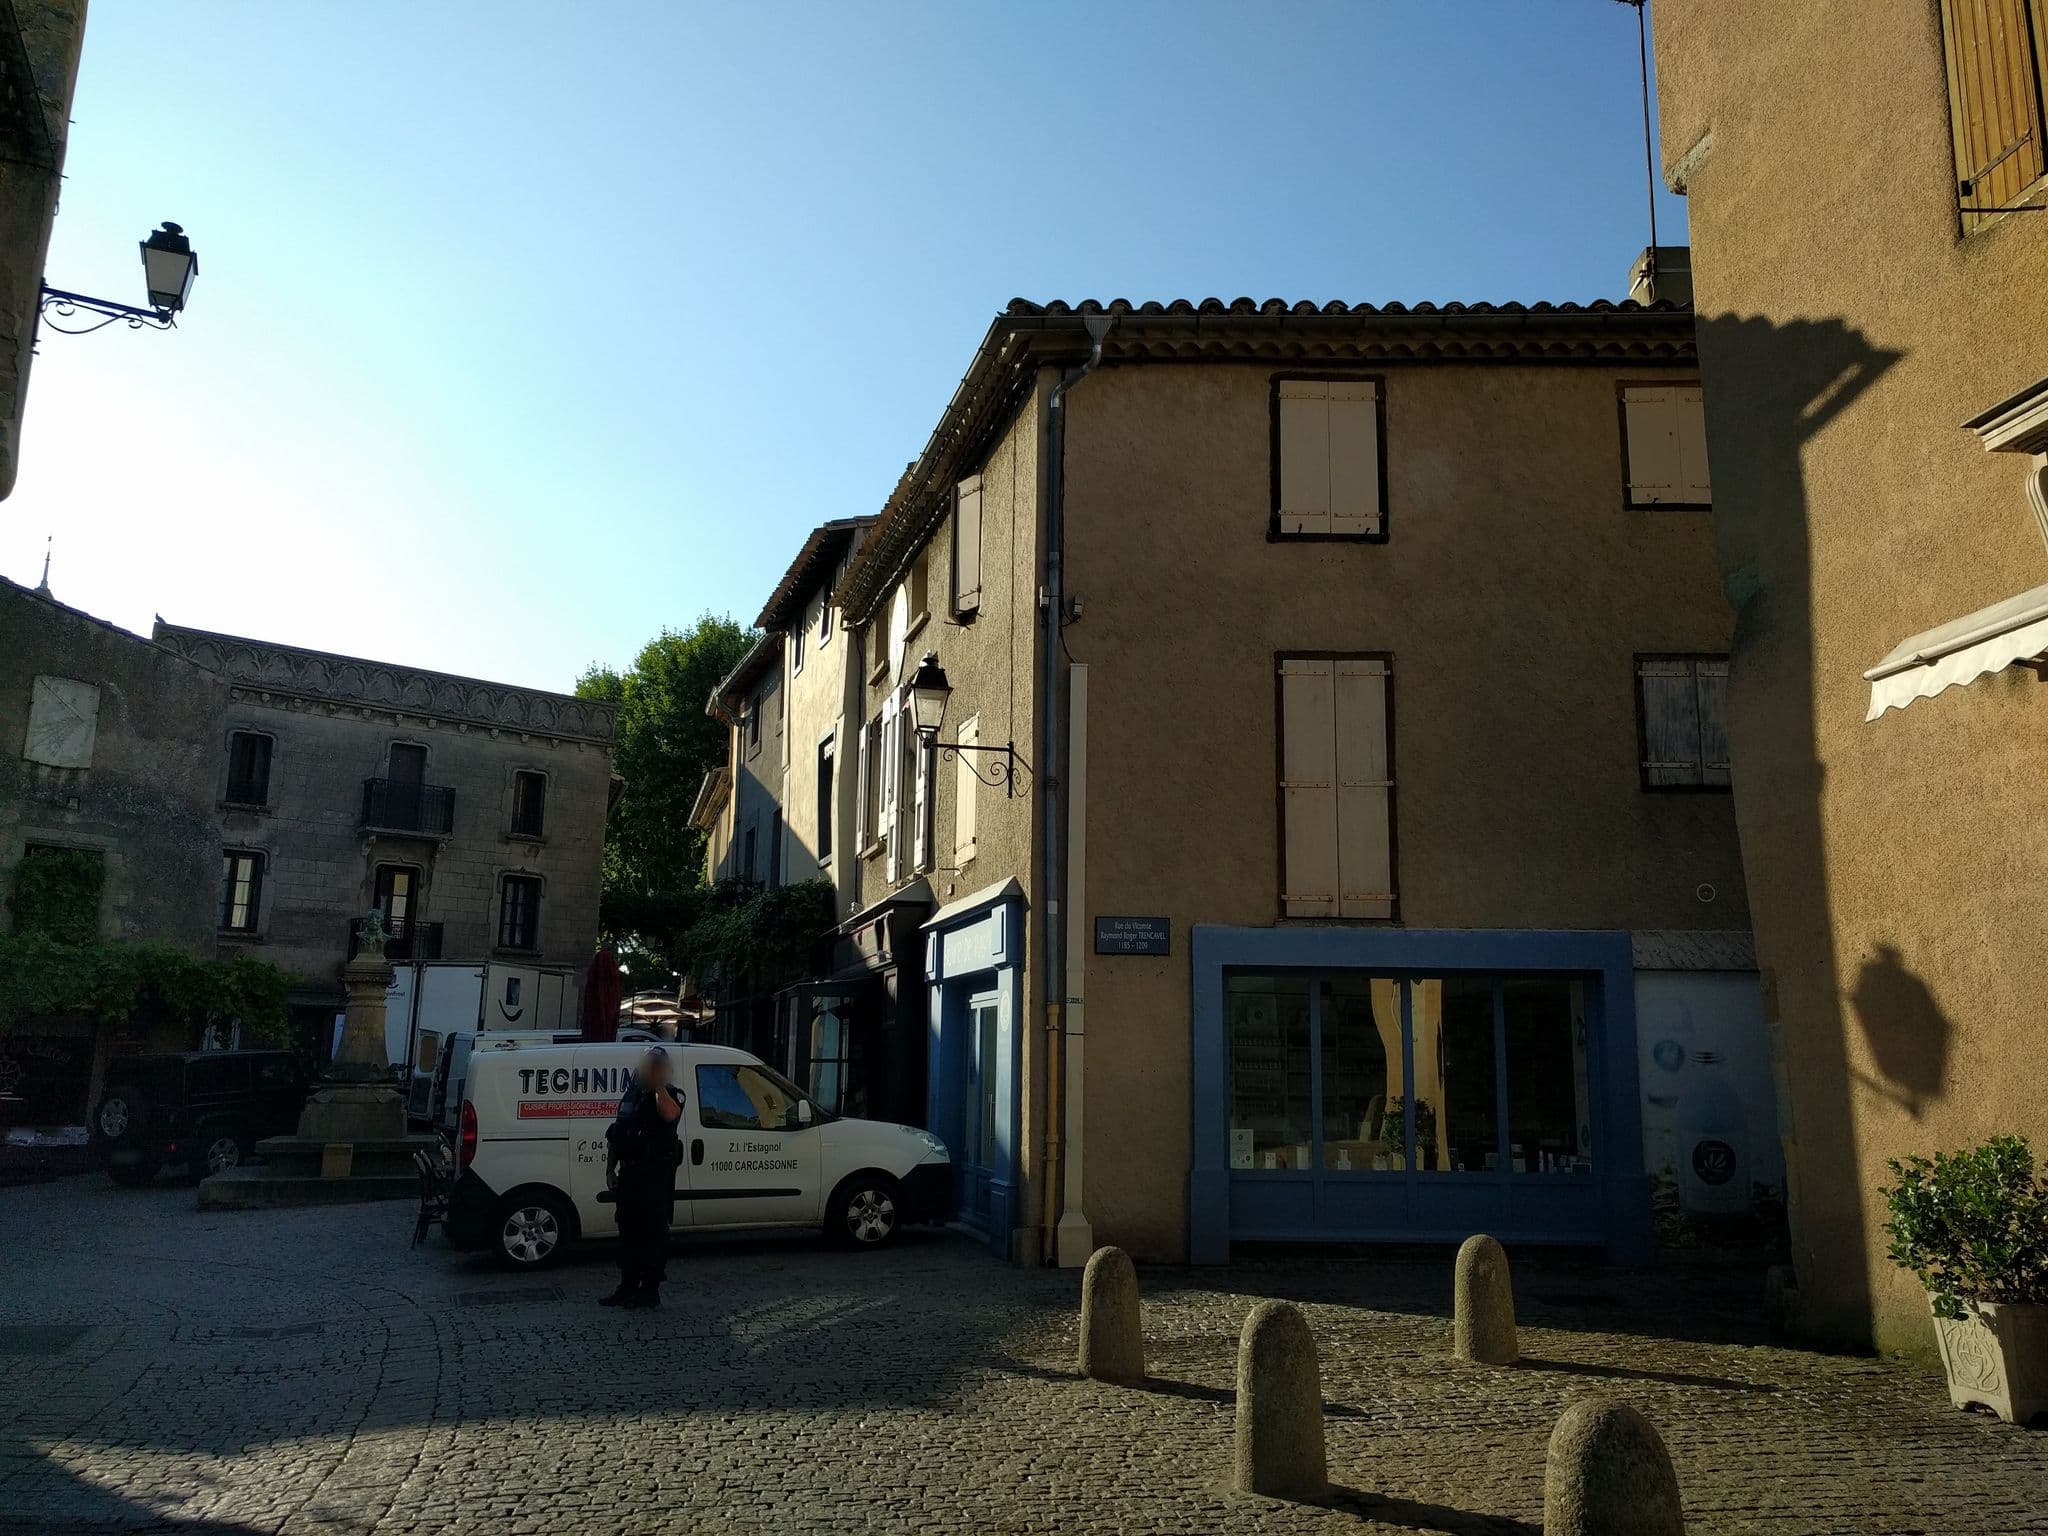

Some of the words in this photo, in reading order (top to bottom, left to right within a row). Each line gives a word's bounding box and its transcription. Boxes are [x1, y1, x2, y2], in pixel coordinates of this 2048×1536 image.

[1100, 931, 1122, 942] Raymond
[1123, 931, 1138, 942] Roger
[1138, 931, 1166, 940] TRENCAVEL
[591, 1141, 603, 1150] 04
[578, 1153, 593, 1162] Fax
[710, 1161, 733, 1171] 11000
[734, 1159, 798, 1171] CARCASSONNE
